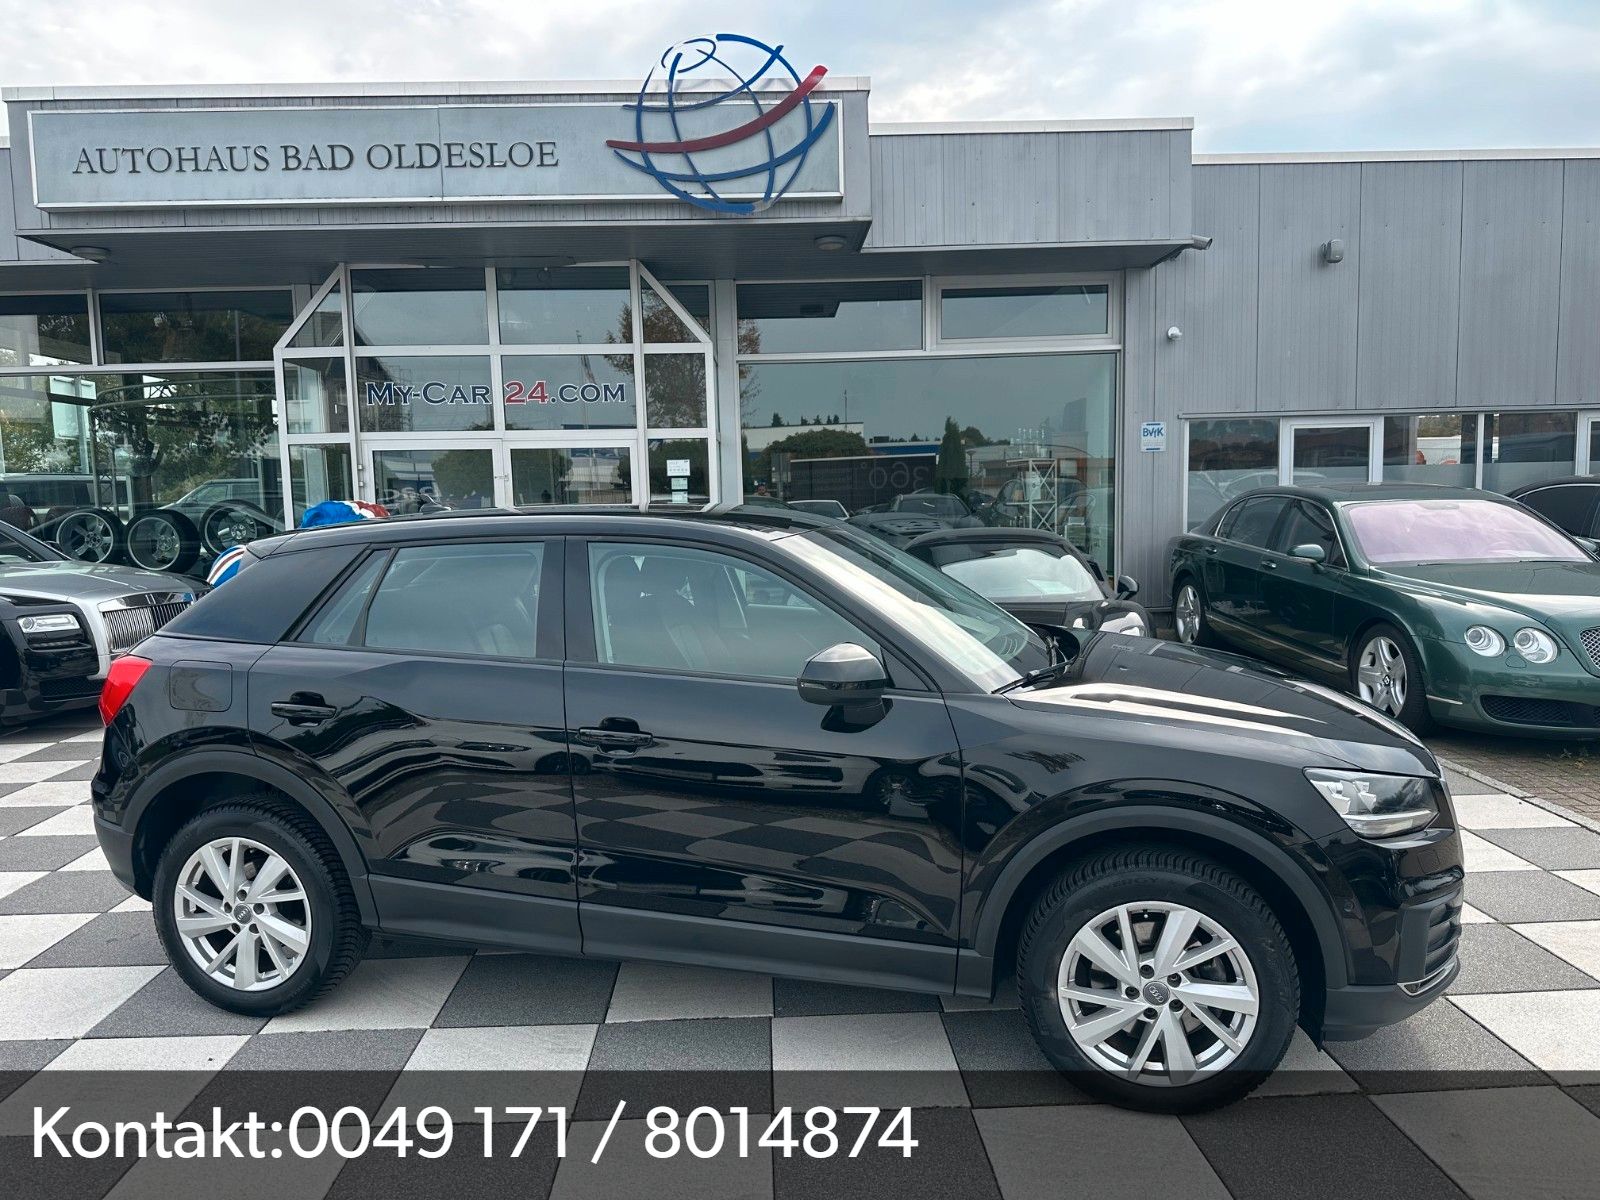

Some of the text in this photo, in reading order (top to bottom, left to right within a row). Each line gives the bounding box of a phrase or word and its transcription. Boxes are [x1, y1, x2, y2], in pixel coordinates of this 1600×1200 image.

[72, 141, 560, 175] AUTOHAUS BAD OLDESLOE
